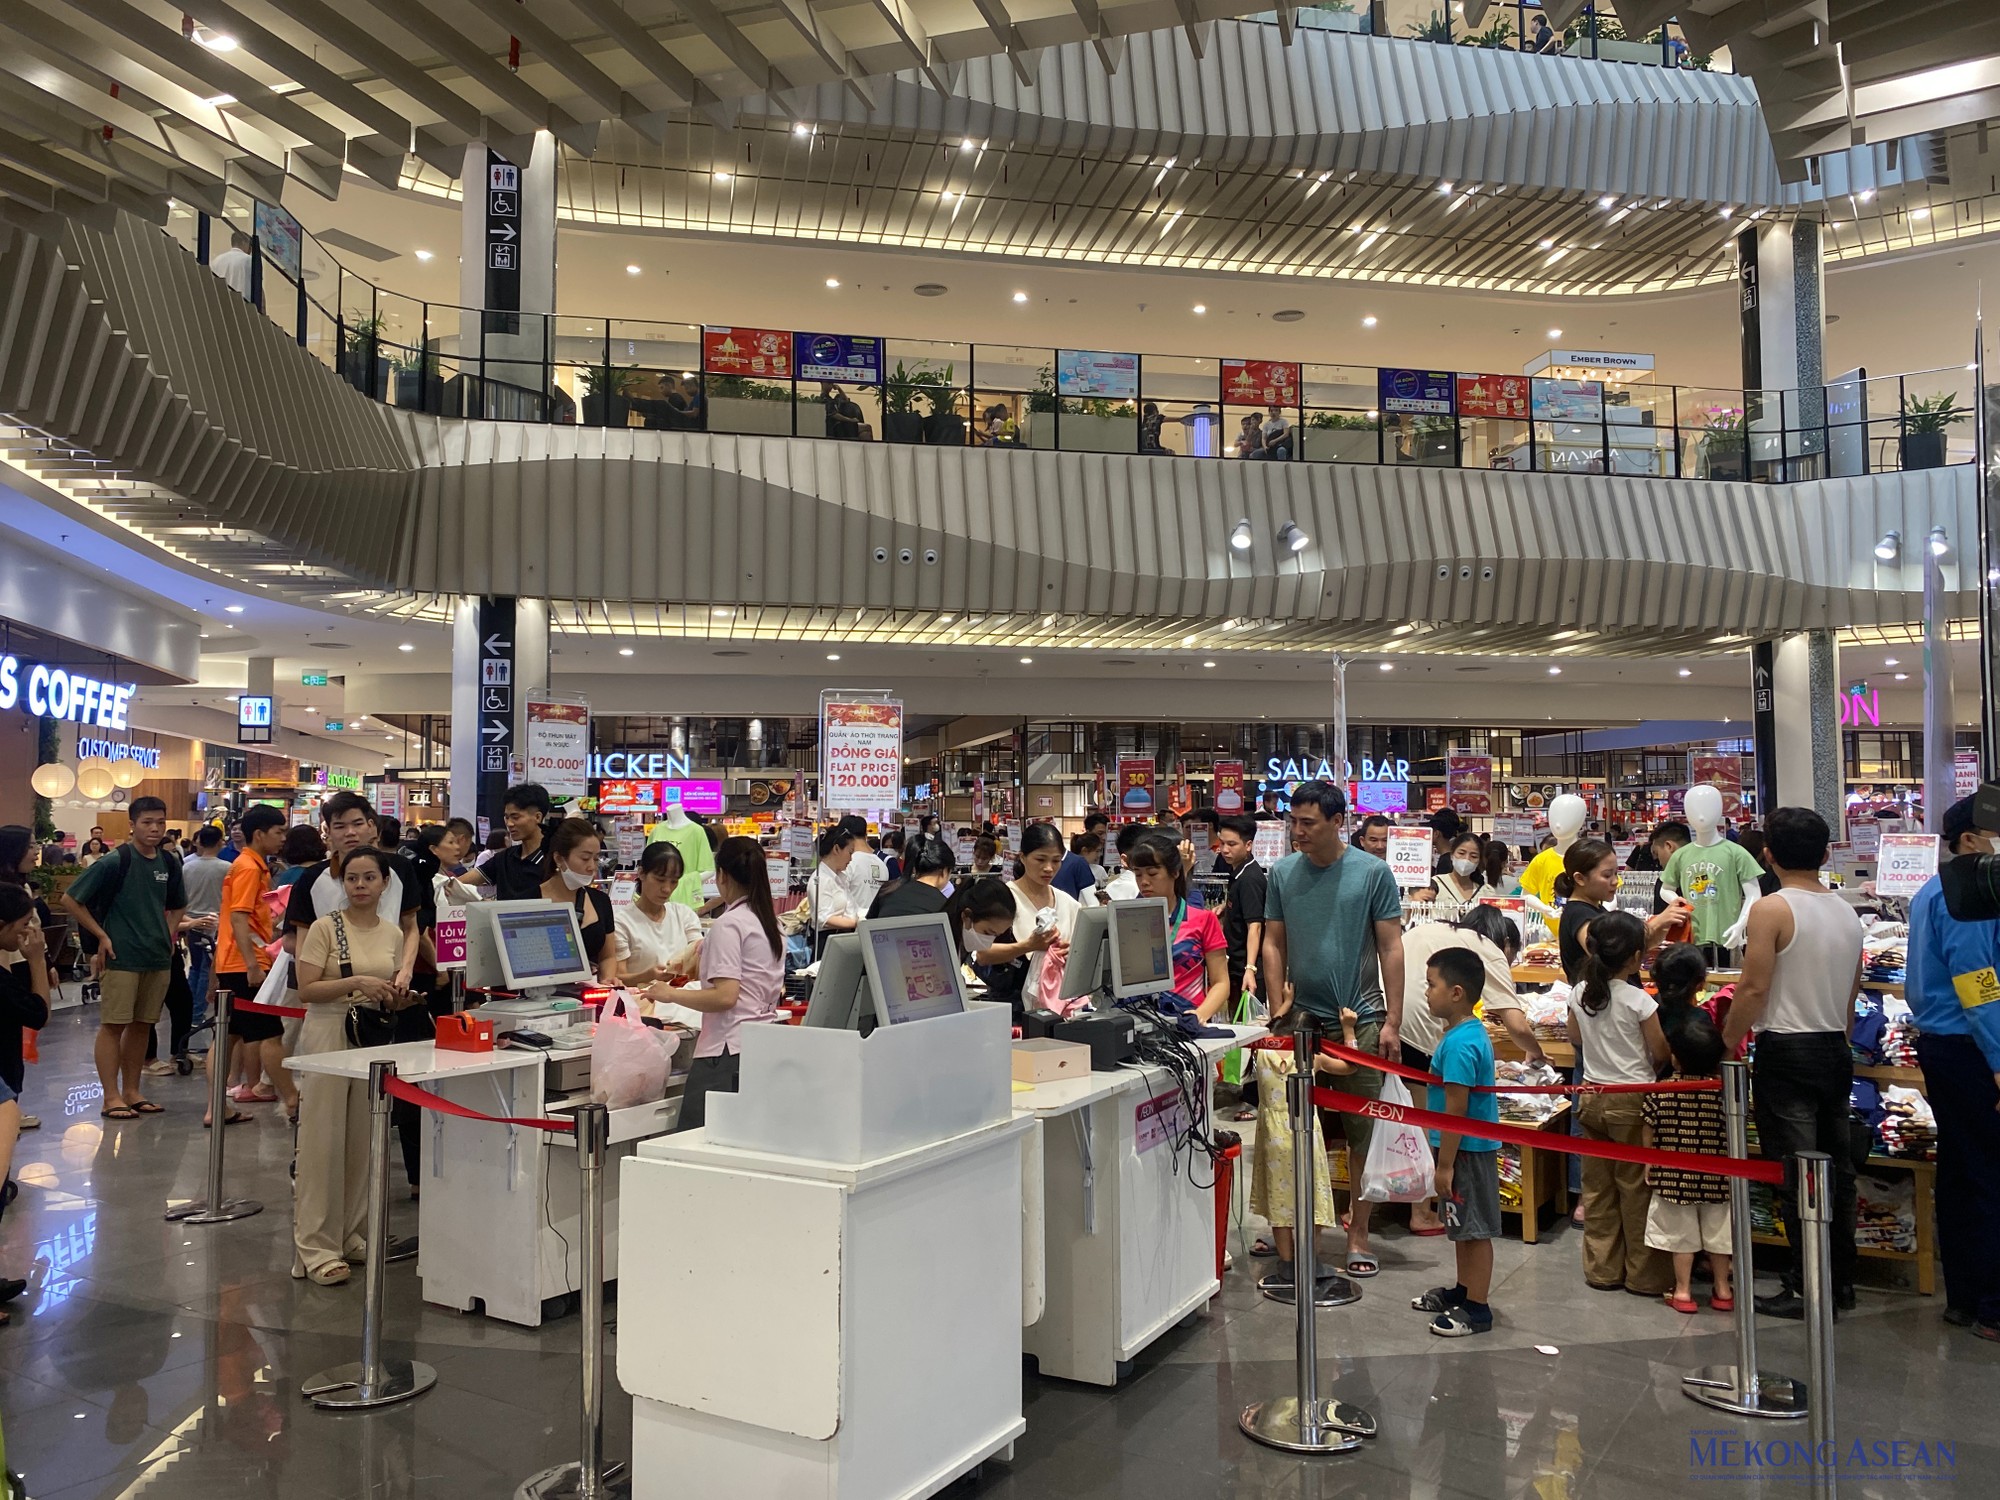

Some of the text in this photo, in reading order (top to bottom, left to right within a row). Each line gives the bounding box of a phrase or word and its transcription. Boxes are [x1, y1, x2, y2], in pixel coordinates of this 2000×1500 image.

[1570, 355, 1637, 365] EMBER BROWN
[0, 656, 129, 731] S COFFEE
[130, 745, 161, 769] SERVICE
[830, 742, 898, 759] ĐỒNG GIÁ
[530, 757, 585, 770] 120.000đ
[830, 763, 896, 772] FLAT PRICE
[1361, 758, 1411, 782] BAR
[830, 774, 896, 787] 120.000đ
[1395, 852, 1411, 862] 02
[1390, 864, 1429, 874] 20.000đ
[1685, 861, 1724, 878] START
[1891, 860, 1910, 870] 02
[440, 924, 456, 938] LỐI
